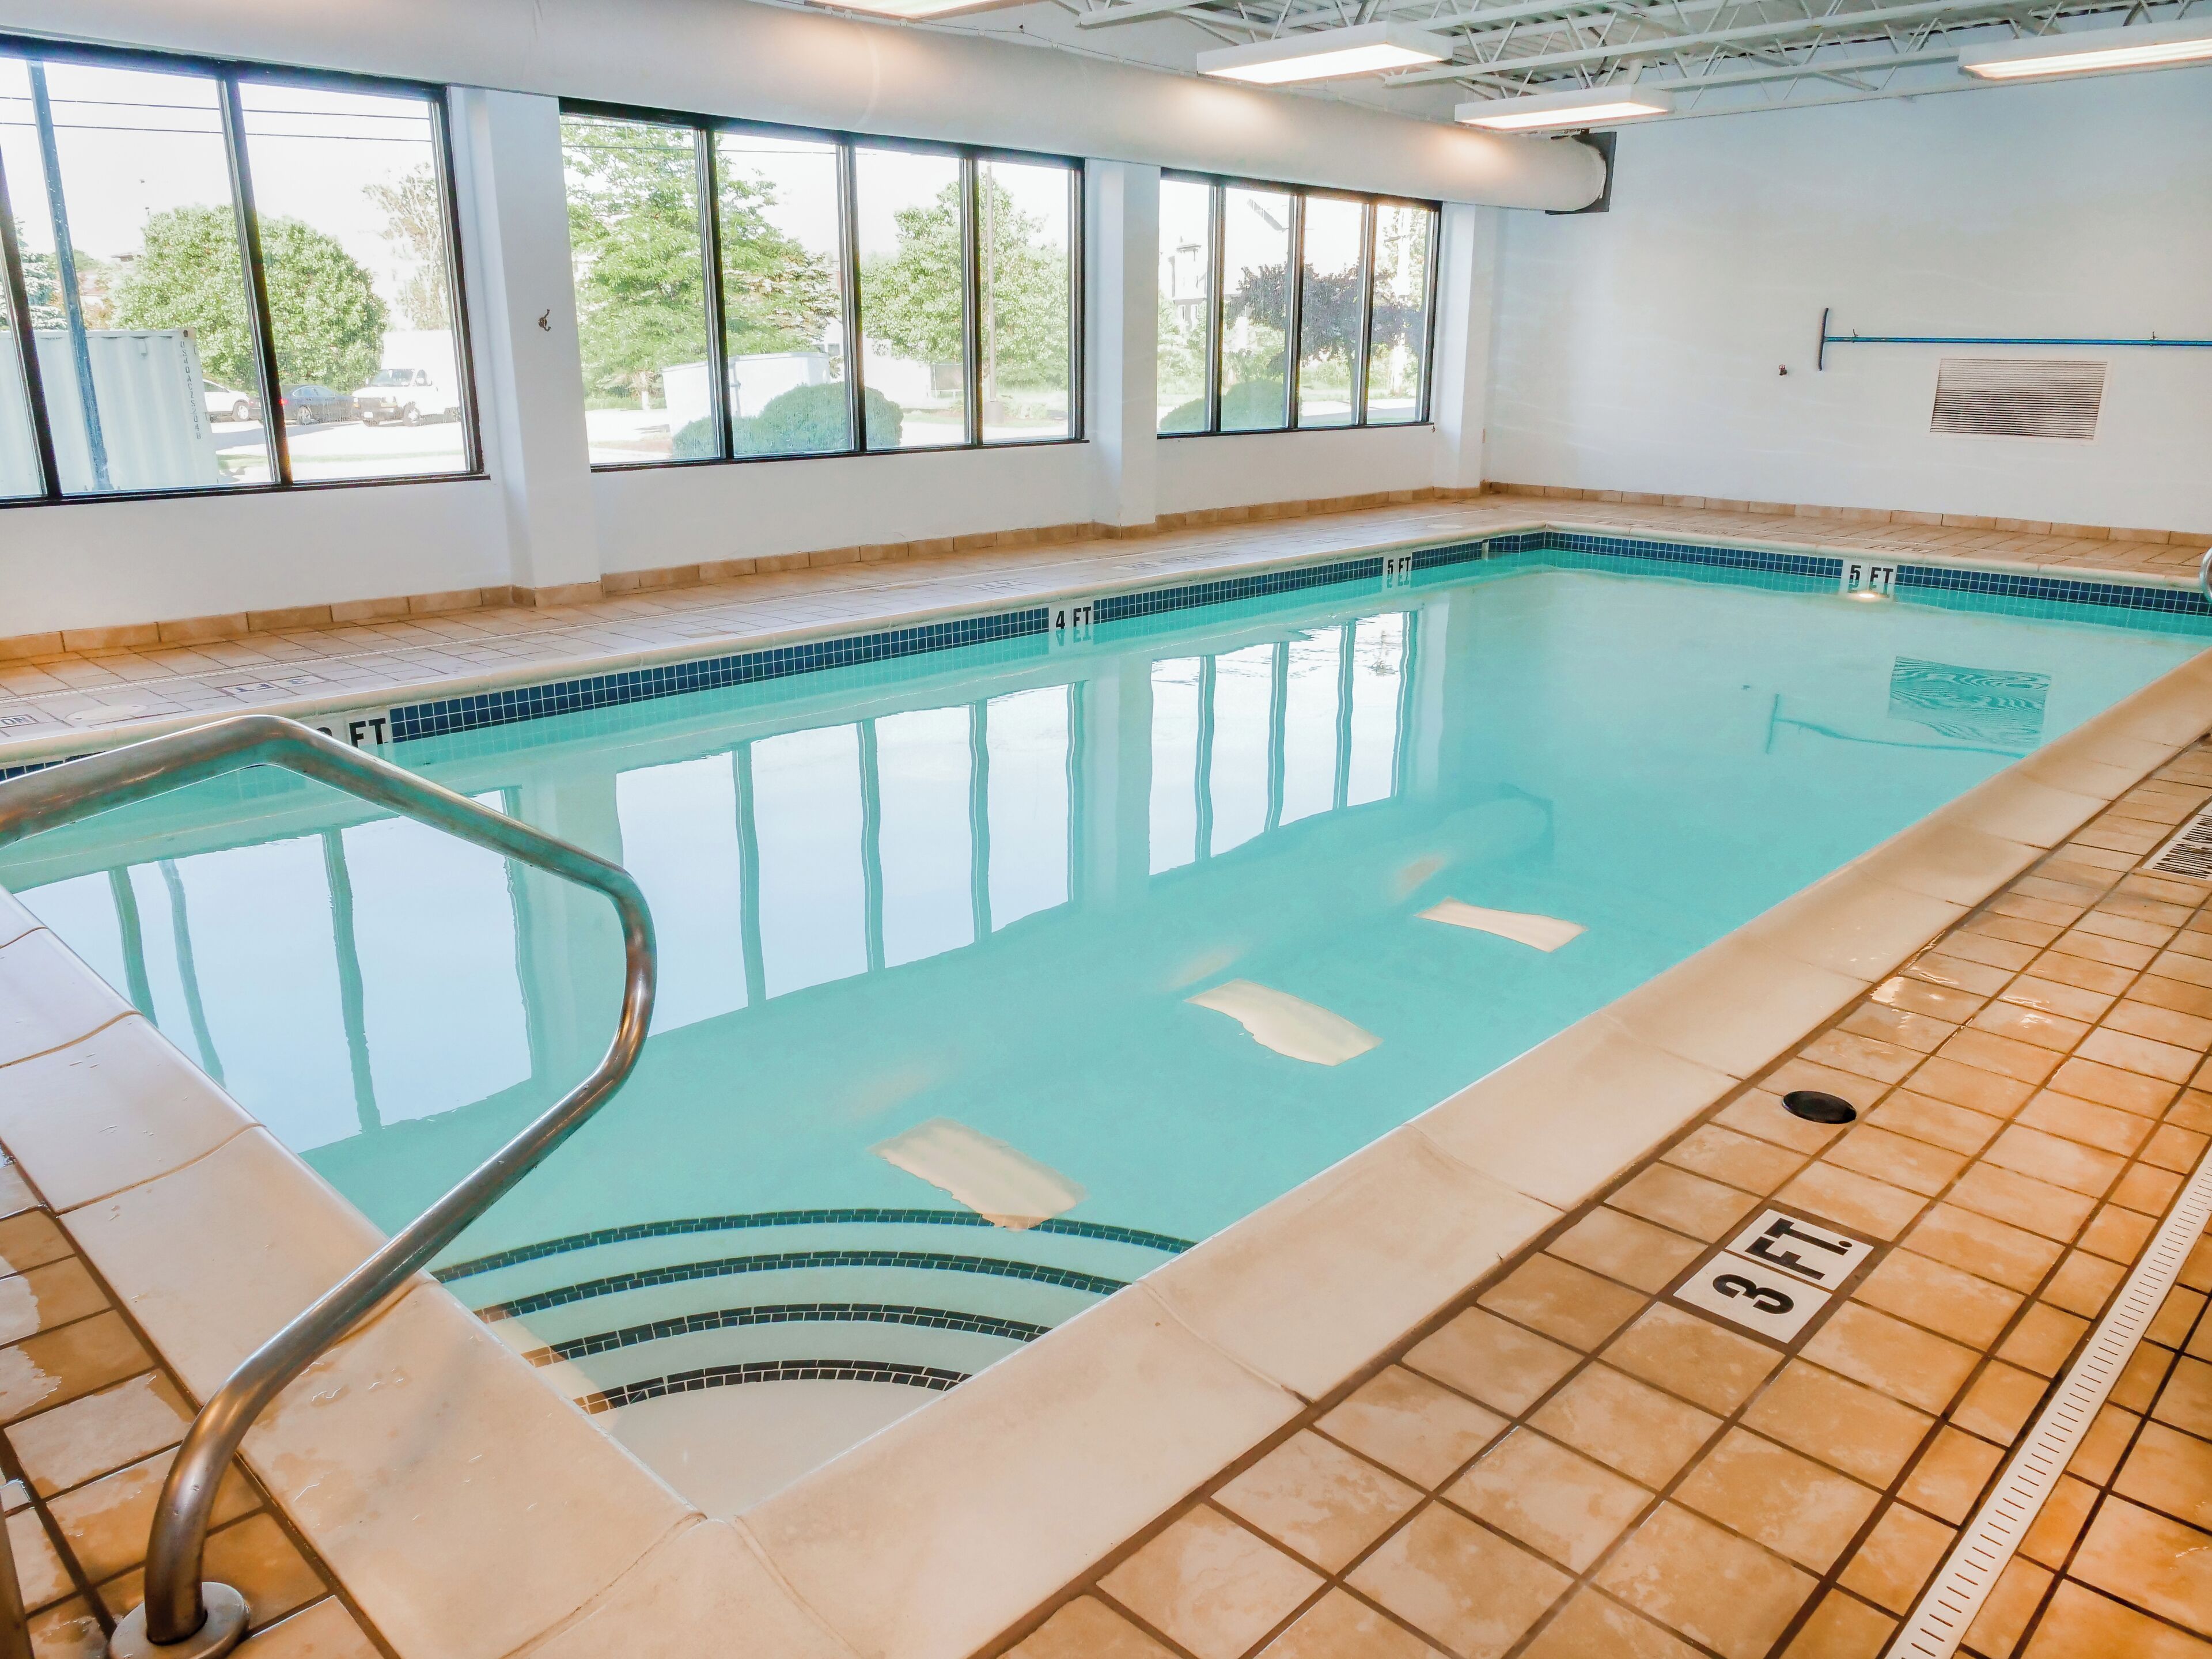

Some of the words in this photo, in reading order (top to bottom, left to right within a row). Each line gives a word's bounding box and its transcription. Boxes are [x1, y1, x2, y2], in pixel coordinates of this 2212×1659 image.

[1399, 556, 1411, 573] FT
[1870, 567, 1894, 584] FT
[1055, 610, 1066, 630] 4
[1073, 606, 1092, 627] FT
[1744, 1217, 1853, 1281] FT.
[1712, 1274, 1794, 1315] 3
